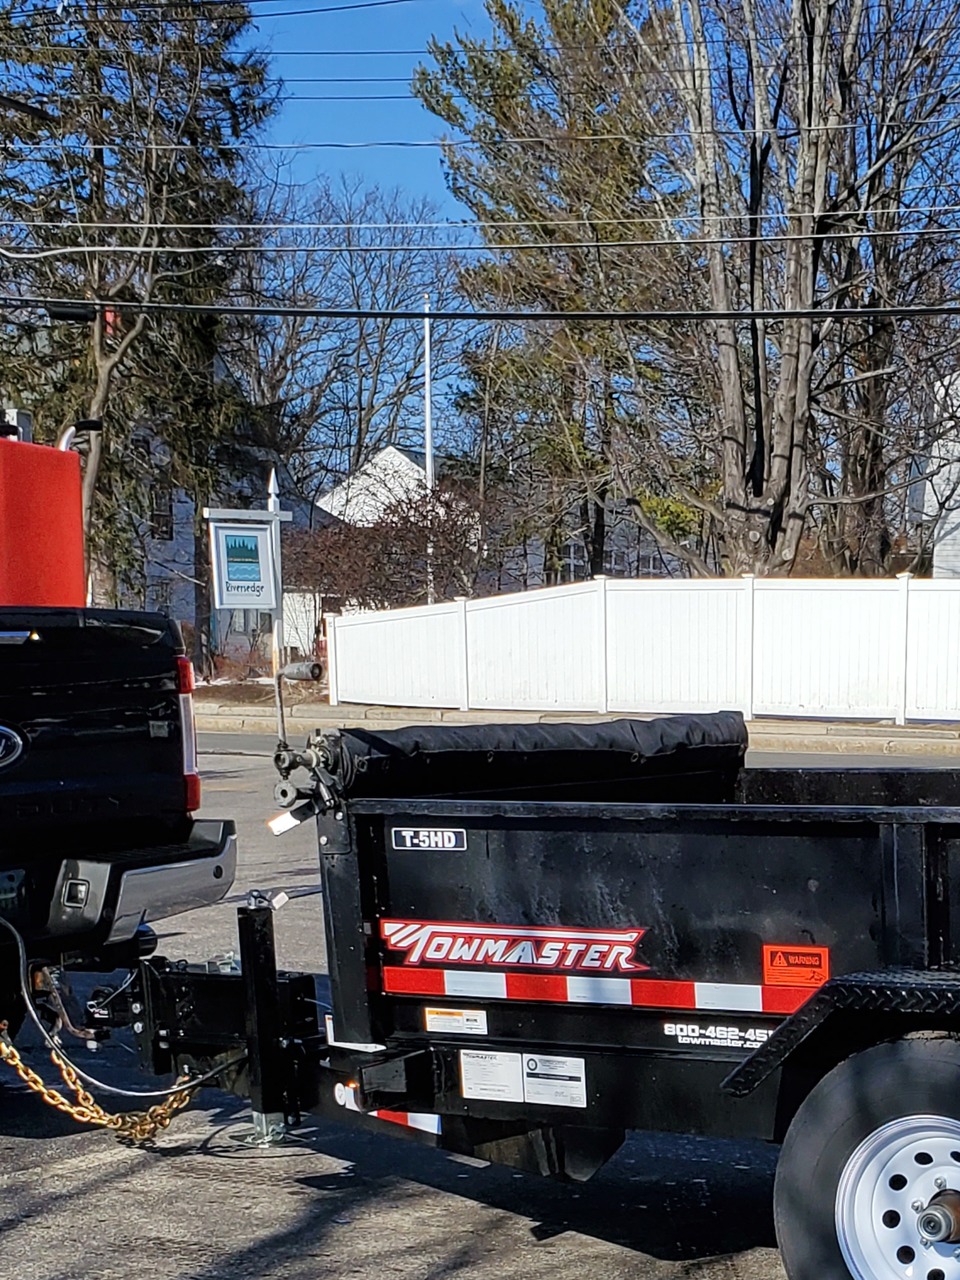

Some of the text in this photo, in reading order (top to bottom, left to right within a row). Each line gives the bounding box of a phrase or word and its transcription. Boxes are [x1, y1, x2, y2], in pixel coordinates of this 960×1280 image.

[225, 581, 265, 597] Riversedge
[401, 831, 457, 848] T-5HD
[384, 922, 640, 970] TOWMASTER
[788, 955, 820, 966] WARNING
